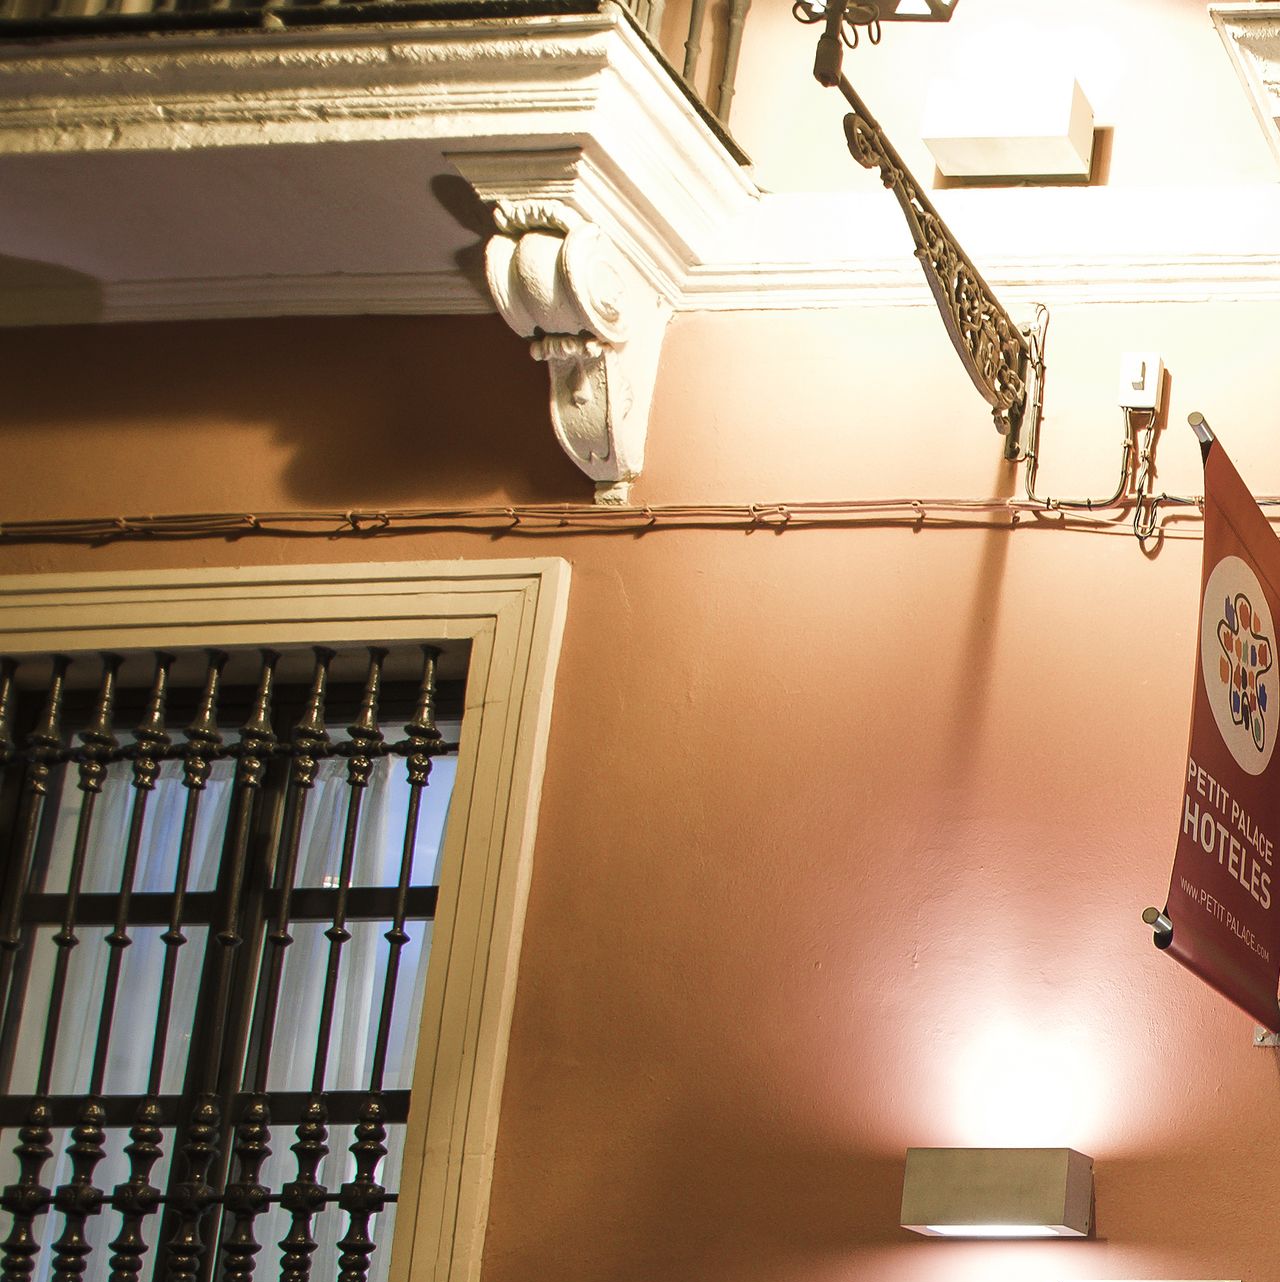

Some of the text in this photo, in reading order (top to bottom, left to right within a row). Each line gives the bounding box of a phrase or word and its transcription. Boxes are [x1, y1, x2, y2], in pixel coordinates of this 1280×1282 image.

[1183, 794, 1271, 910] HOTELES
[1188, 756, 1273, 867] PETIT PALACE
